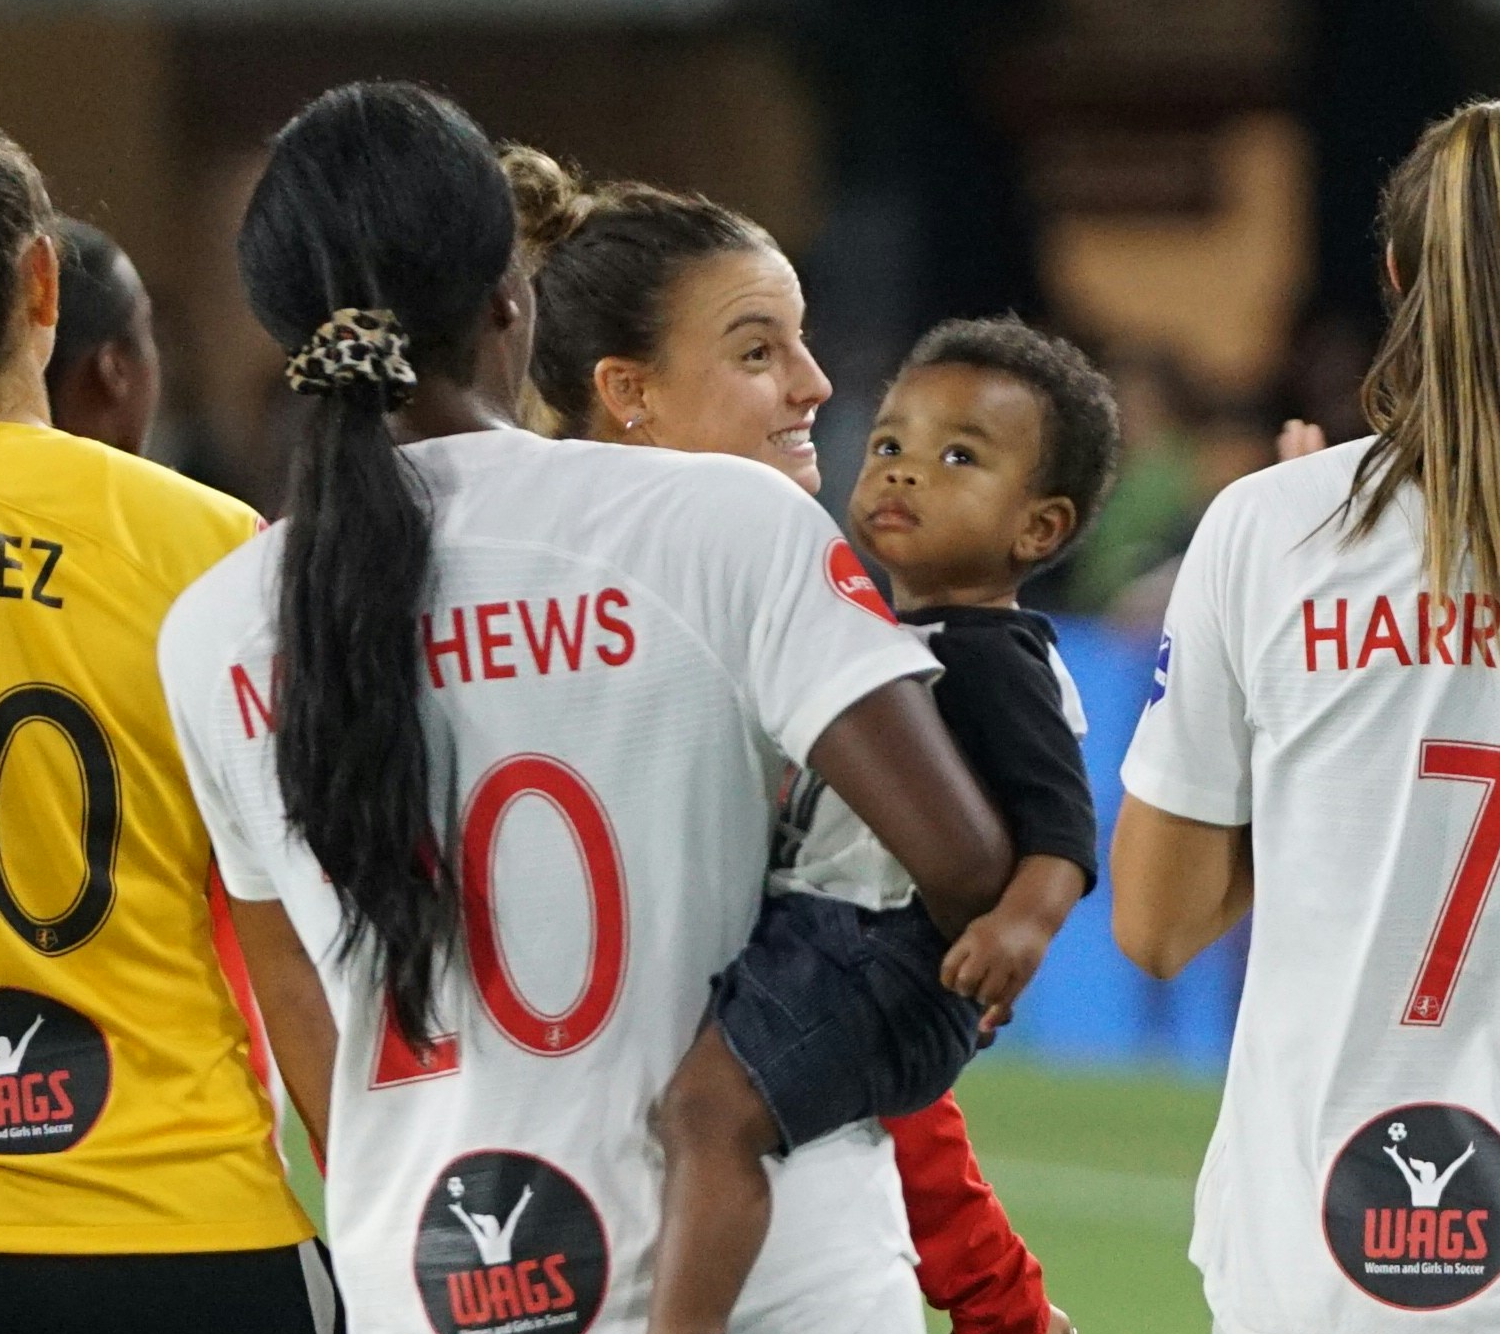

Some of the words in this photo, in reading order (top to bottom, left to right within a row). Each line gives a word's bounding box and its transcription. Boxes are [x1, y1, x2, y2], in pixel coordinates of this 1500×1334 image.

[230, 587, 636, 740] MHEWS
[1364, 1208, 1488, 1260] WAGS
[446, 1253, 575, 1325] WAGS
[1365, 1262, 1400, 1274] Women
[1402, 1262, 1420, 1274] and
[1421, 1262, 1442, 1274] Girls
[1454, 1262, 1485, 1275] Soccer
